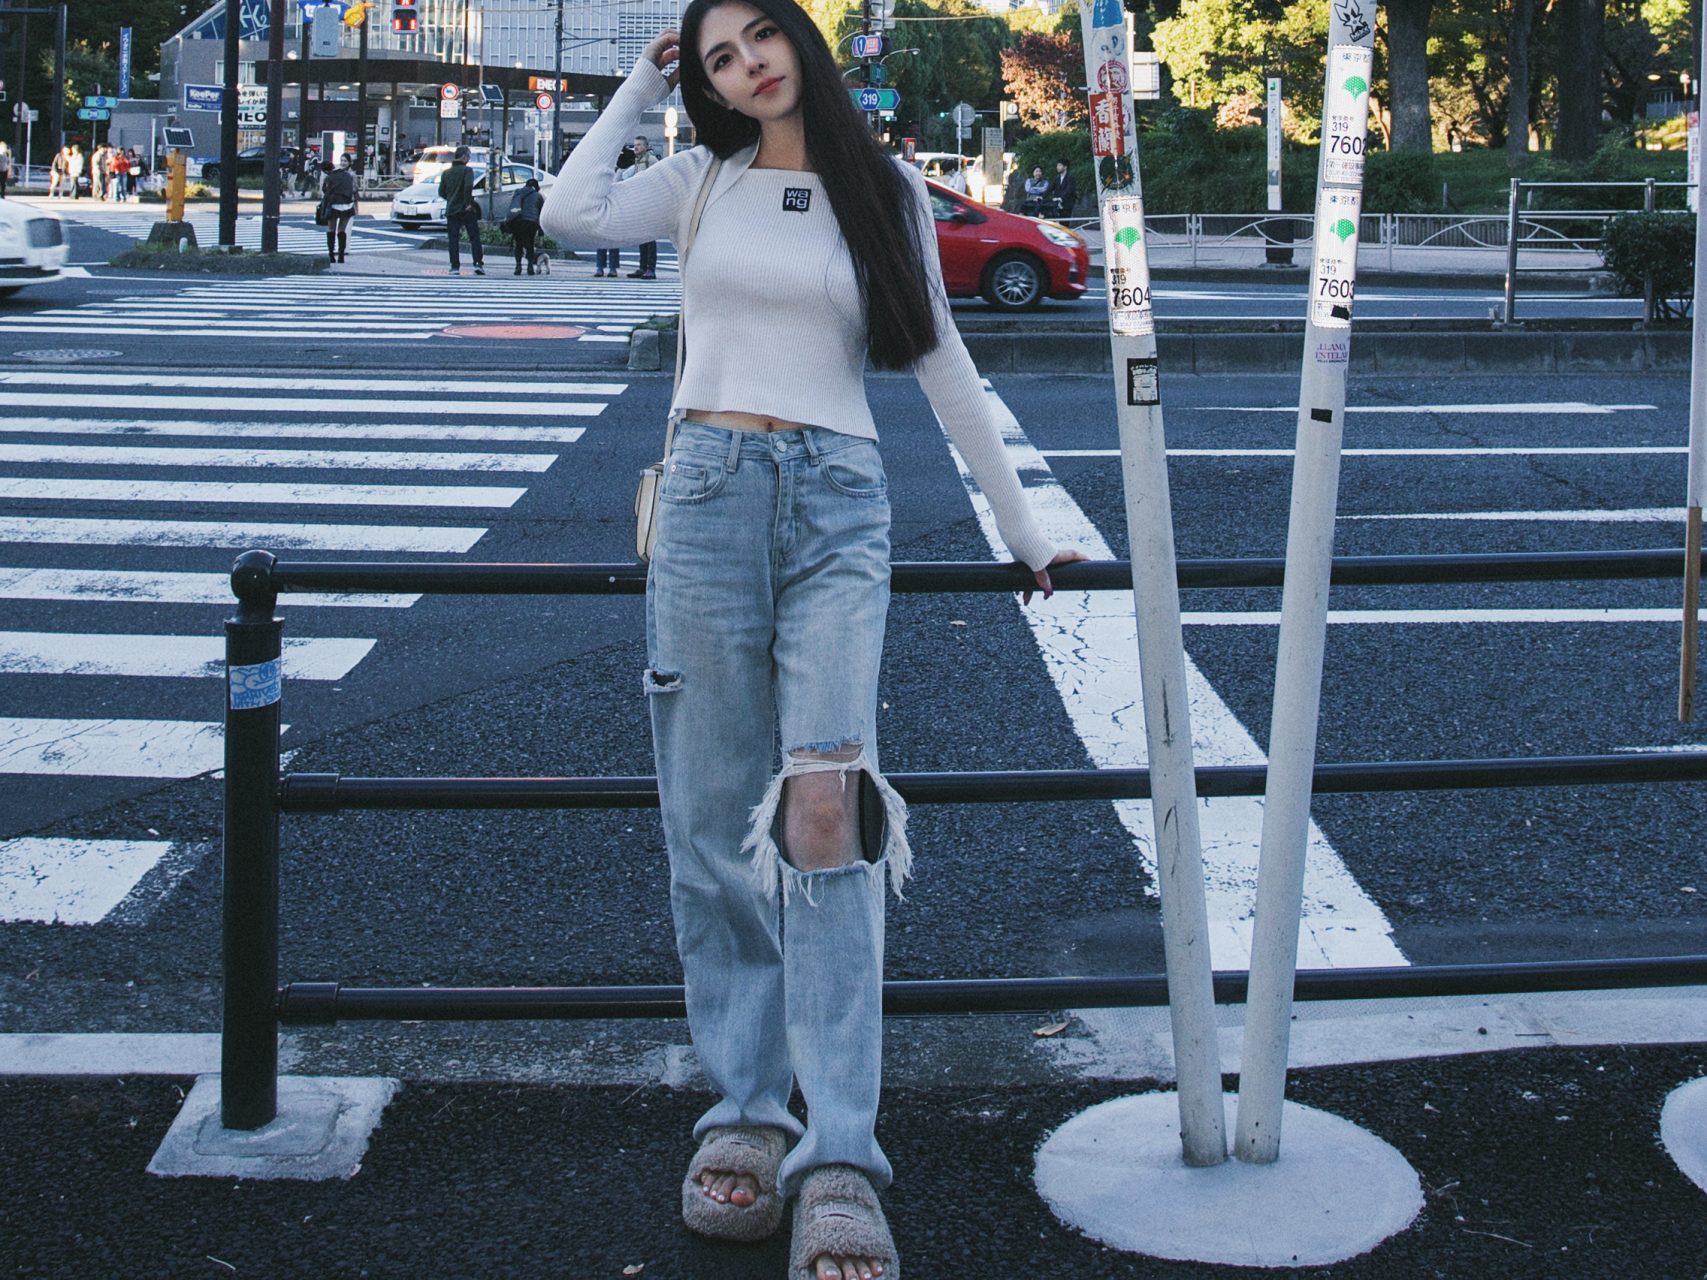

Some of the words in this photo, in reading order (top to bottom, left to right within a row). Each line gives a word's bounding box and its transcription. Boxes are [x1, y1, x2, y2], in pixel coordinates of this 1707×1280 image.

[862, 93, 878, 105] 319
[1331, 121, 1349, 132] 319
[1320, 264, 1337, 275] 319
[1111, 274, 1127, 285] 319
[1111, 286, 1151, 307] 7604
